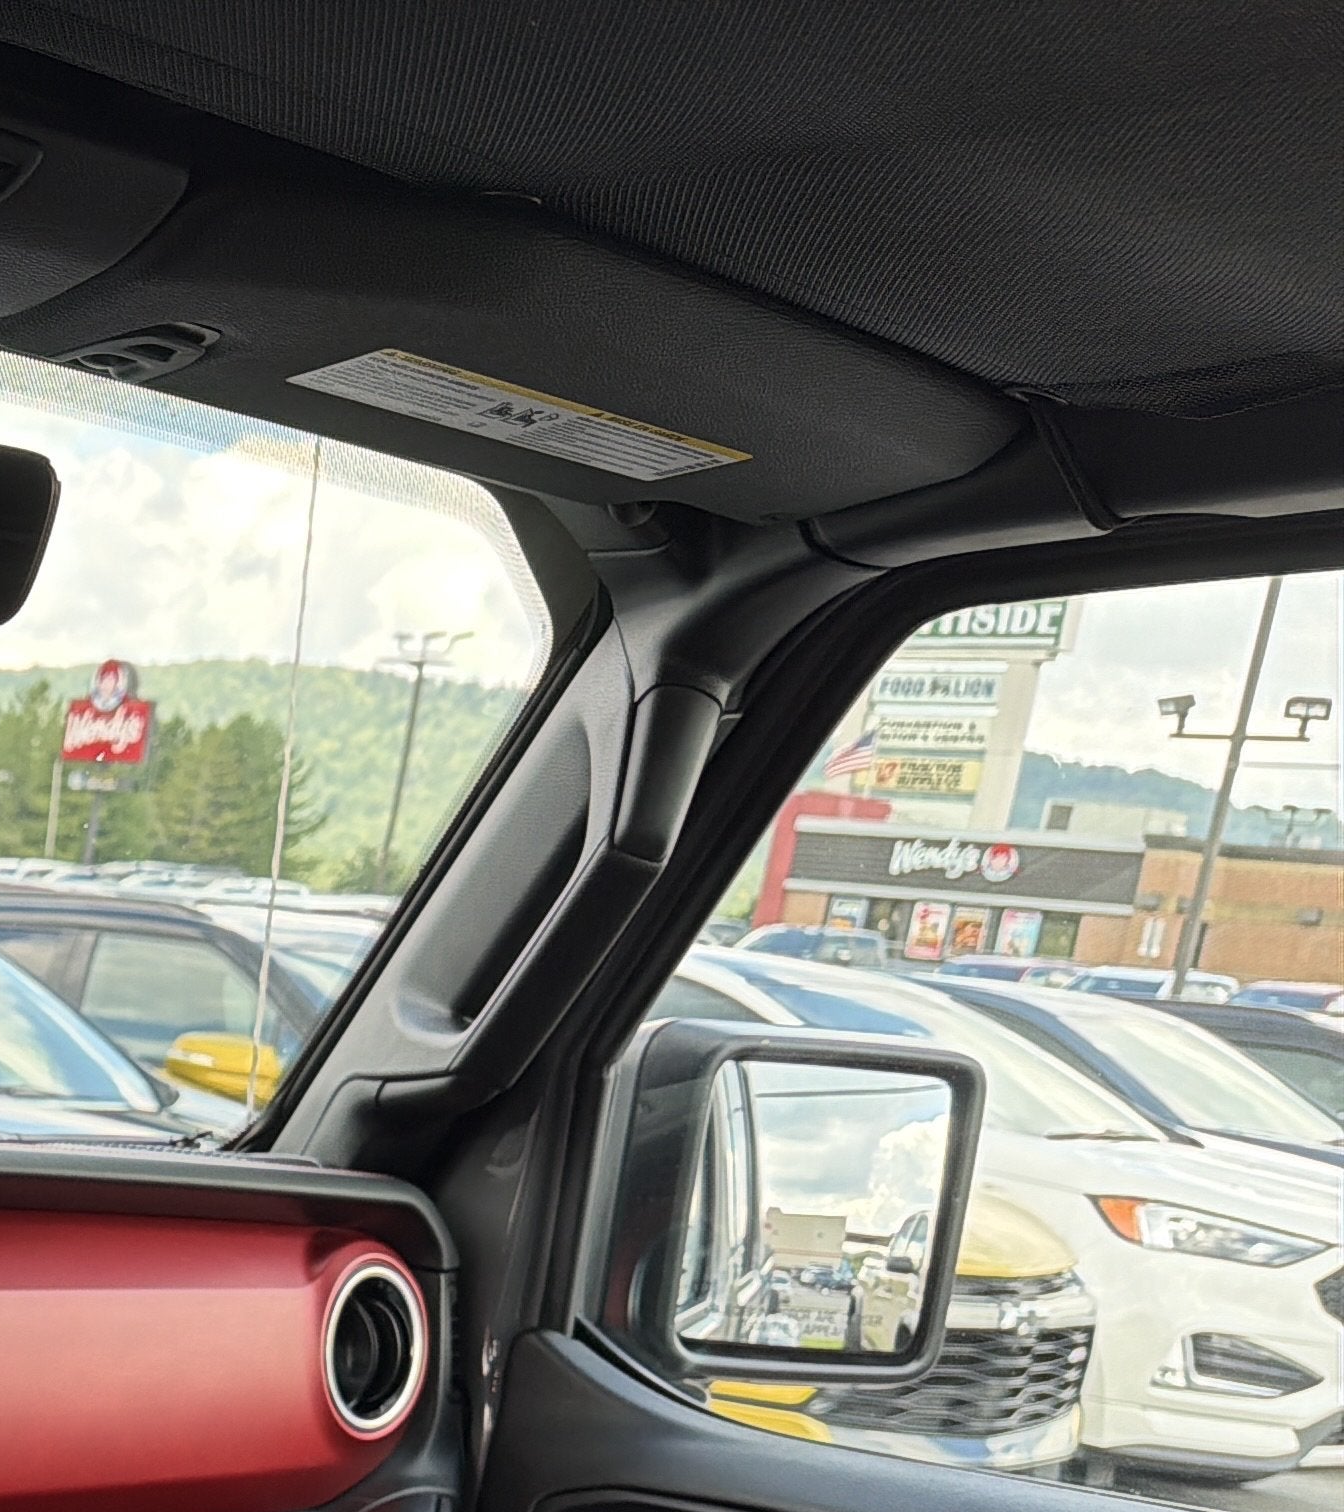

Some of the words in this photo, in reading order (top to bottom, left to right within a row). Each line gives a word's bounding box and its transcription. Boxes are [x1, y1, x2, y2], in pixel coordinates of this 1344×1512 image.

[878, 676, 927, 697] FOOD
[953, 677, 996, 697] LION
[63, 704, 145, 755] Wendy's
[888, 836, 981, 880] Wendy's
